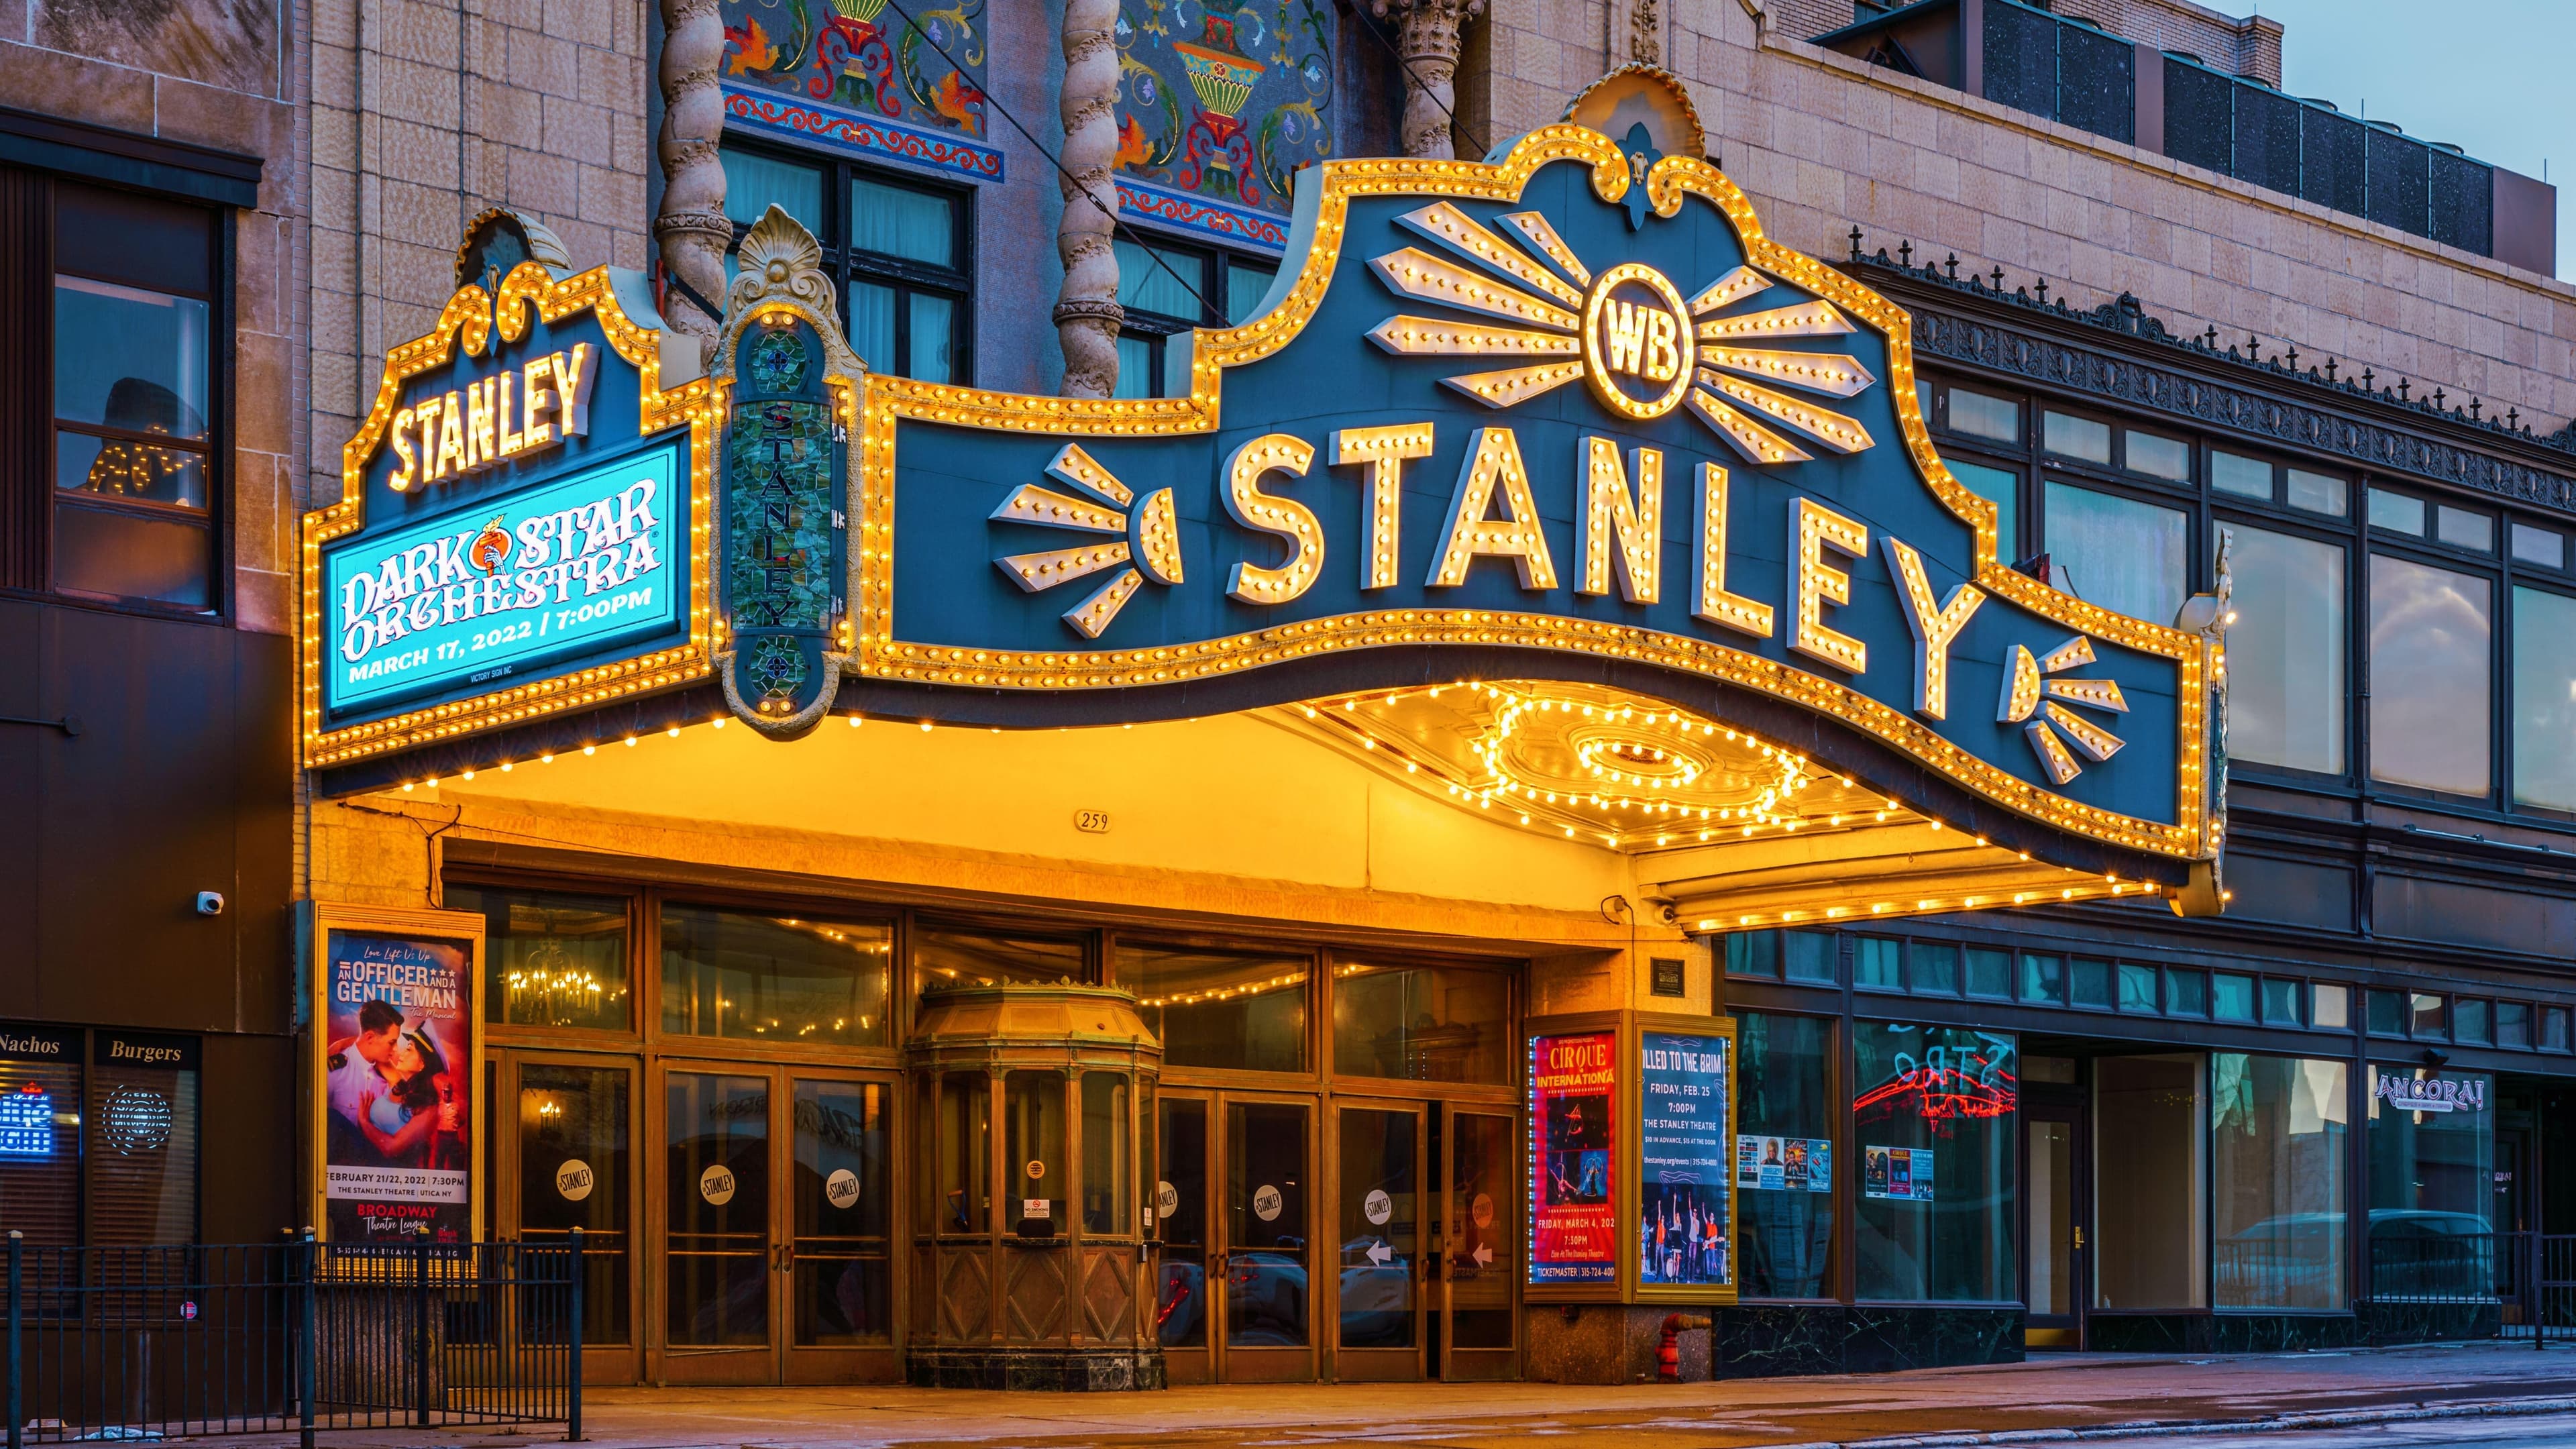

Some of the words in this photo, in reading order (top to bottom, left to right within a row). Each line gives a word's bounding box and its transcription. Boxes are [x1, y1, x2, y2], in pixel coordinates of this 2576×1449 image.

[1601, 297, 1679, 382] WB
[389, 342, 599, 493] STANLEY
[759, 405, 795, 627] STANLEY
[340, 530, 476, 632] DARK
[515, 478, 660, 570] STAR
[1220, 422, 1985, 721] STANLEY
[340, 531, 662, 663] ORCHESTRA
[349, 647, 428, 684] MARCH
[436, 639, 466, 659] 17,
[472, 621, 533, 652] 2022
[557, 588, 653, 630] 7:00PM
[470, 671, 490, 683] VICTORY
[491, 667, 502, 678] SIGN
[503, 665, 512, 675] INC
[1081, 812, 1108, 830] 259
[364, 945, 382, 959] Love
[384, 947, 402, 963] Lift
[404, 947, 415, 960] Us
[418, 949, 431, 963] Up
[338, 970, 351, 980] AN
[352, 961, 428, 987] OFFICER
[430, 977, 448, 988] AND
[449, 979, 456, 988] A
[337, 981, 456, 1010] GENTLEMAN
[411, 1008, 423, 1017] The
[425, 1009, 456, 1020] Musical
[0, 1034, 60, 1054] Nachos
[110, 1040, 182, 1062] Burgers
[1550, 1044, 1606, 1073] CIRQUE
[1669, 1051, 1680, 1071] TO
[1682, 1053, 1698, 1073] THE
[1700, 1053, 1721, 1074] BRIM
[1537, 1069, 1615, 1087] INTERNATIONA
[1650, 1083, 1682, 1097] FRIDAY,
[1683, 1085, 1700, 1096] FEB.
[1701, 1086, 1711, 1096] 25
[2375, 1075, 2484, 1111] ANCORA!
[1668, 1102, 1696, 1114] 7:00PM
[1644, 1118, 1658, 1128] THE
[1659, 1120, 1689, 1130] STANLEY
[1690, 1121, 1716, 1131] THEATRE
[1644, 1156, 1689, 1166] thestanley.org/events
[376, 1175, 402, 1185] 21/22,
[405, 1176, 426, 1185] 2022
[432, 1177, 464, 1186] 7:30PM
[561, 1169, 591, 1191] STANLEY
[704, 1174, 733, 1196] STANLEY
[830, 1178, 857, 1199] STANLEY
[1159, 1189, 1176, 1208] ANLEY
[1257, 1193, 1280, 1213] STANLEY
[1368, 1197, 1389, 1217] STANLEY
[357, 1203, 437, 1218] BROADWAY
[362, 1216, 397, 1234] Theatre
[400, 1218, 427, 1235] League
[1538, 1220, 1564, 1230] FRIDAY,
[1566, 1219, 1589, 1228] MARCH
[1591, 1218, 1599, 1229] 4,
[1601, 1218, 1615, 1228] 202
[1564, 1236, 1587, 1245] 7:30PM
[1573, 1249, 1588, 1260] Stanley
[1588, 1249, 1604, 1257] Theatre
[1537, 1267, 1578, 1277] TICKETMASTER
[1581, 1267, 1615, 1277] 315-724-400
